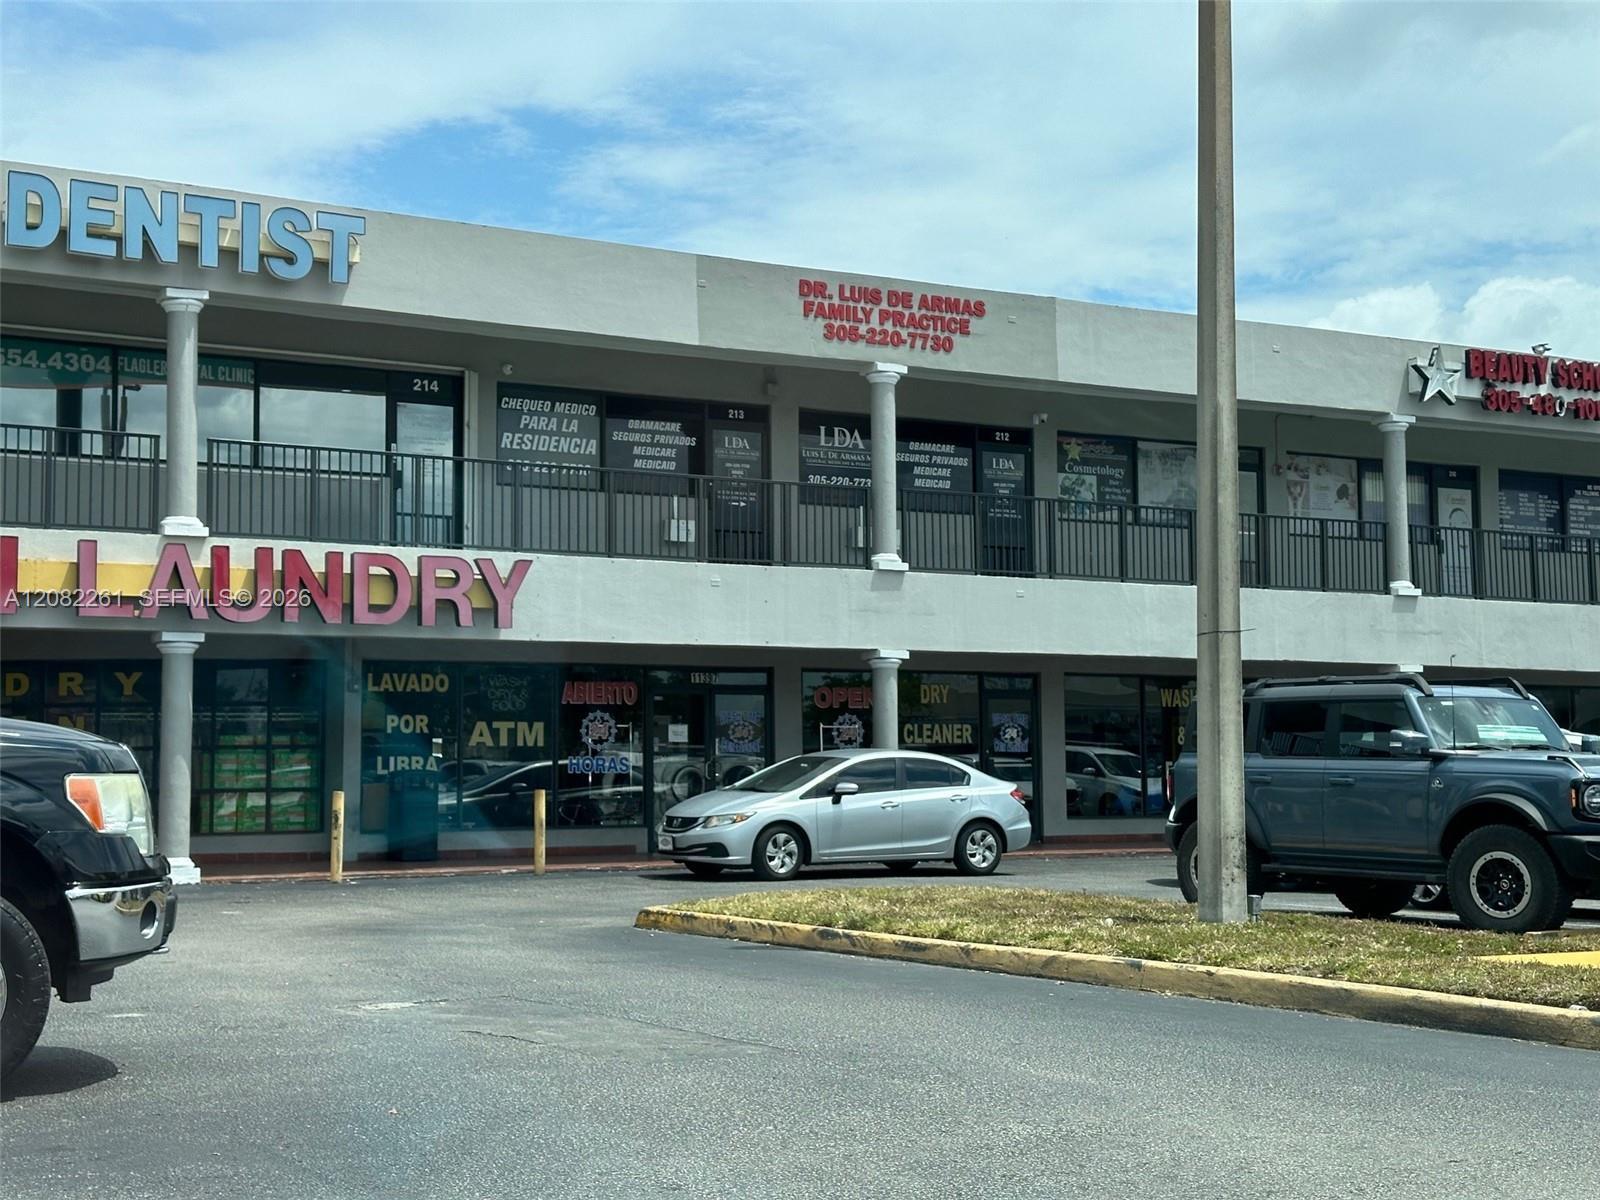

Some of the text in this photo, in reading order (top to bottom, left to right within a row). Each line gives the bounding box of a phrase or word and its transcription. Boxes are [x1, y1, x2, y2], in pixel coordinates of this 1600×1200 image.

[5, 169, 366, 285] DENTIST
[799, 279, 986, 317] DR. LUIS DE ARMAS
[803, 300, 971, 335] FAMILY PRACTICE
[823, 322, 954, 353] 305-220-7730
[117, 354, 168, 376] FLAGLER
[218, 365, 255, 384] CLINIC
[1466, 349, 1549, 386] BEAUTY
[413, 379, 439, 393] 214
[501, 397, 597, 417] CHEQUEO MEDICO
[728, 409, 745, 419] 213
[520, 415, 579, 433] PARA LA
[628, 419, 682, 433] OBAMACARE
[501, 432, 597, 455] RESIDENCIA
[612, 431, 697, 447] SEGUROS PRIVADOS
[724, 436, 751, 450] LDA
[819, 426, 865, 449] LDA
[995, 432, 1010, 441] 212
[632, 446, 677, 458] MEDICARE
[909, 441, 955, 454] OBAMACARE
[633, 459, 677, 471] MEDICAID
[896, 453, 968, 467] SEGUROS PRIVADOS
[992, 457, 1015, 470] LDA
[913, 466, 951, 477] MEDICARE
[1064, 462, 1126, 479] Cosmetology
[807, 474, 872, 487] 305-220-773
[914, 478, 951, 489] MEDICAID
[76, 539, 534, 628] LAUNDRY
[368, 673, 449, 693] LAVADO
[561, 681, 638, 705] ABIERTO
[920, 685, 950, 704] DRY
[1160, 688, 1193, 708] WAS
[386, 715, 428, 734] POR
[469, 721, 545, 747] ATM
[904, 724, 973, 744] CLEANER
[568, 756, 630, 774] HORAS
